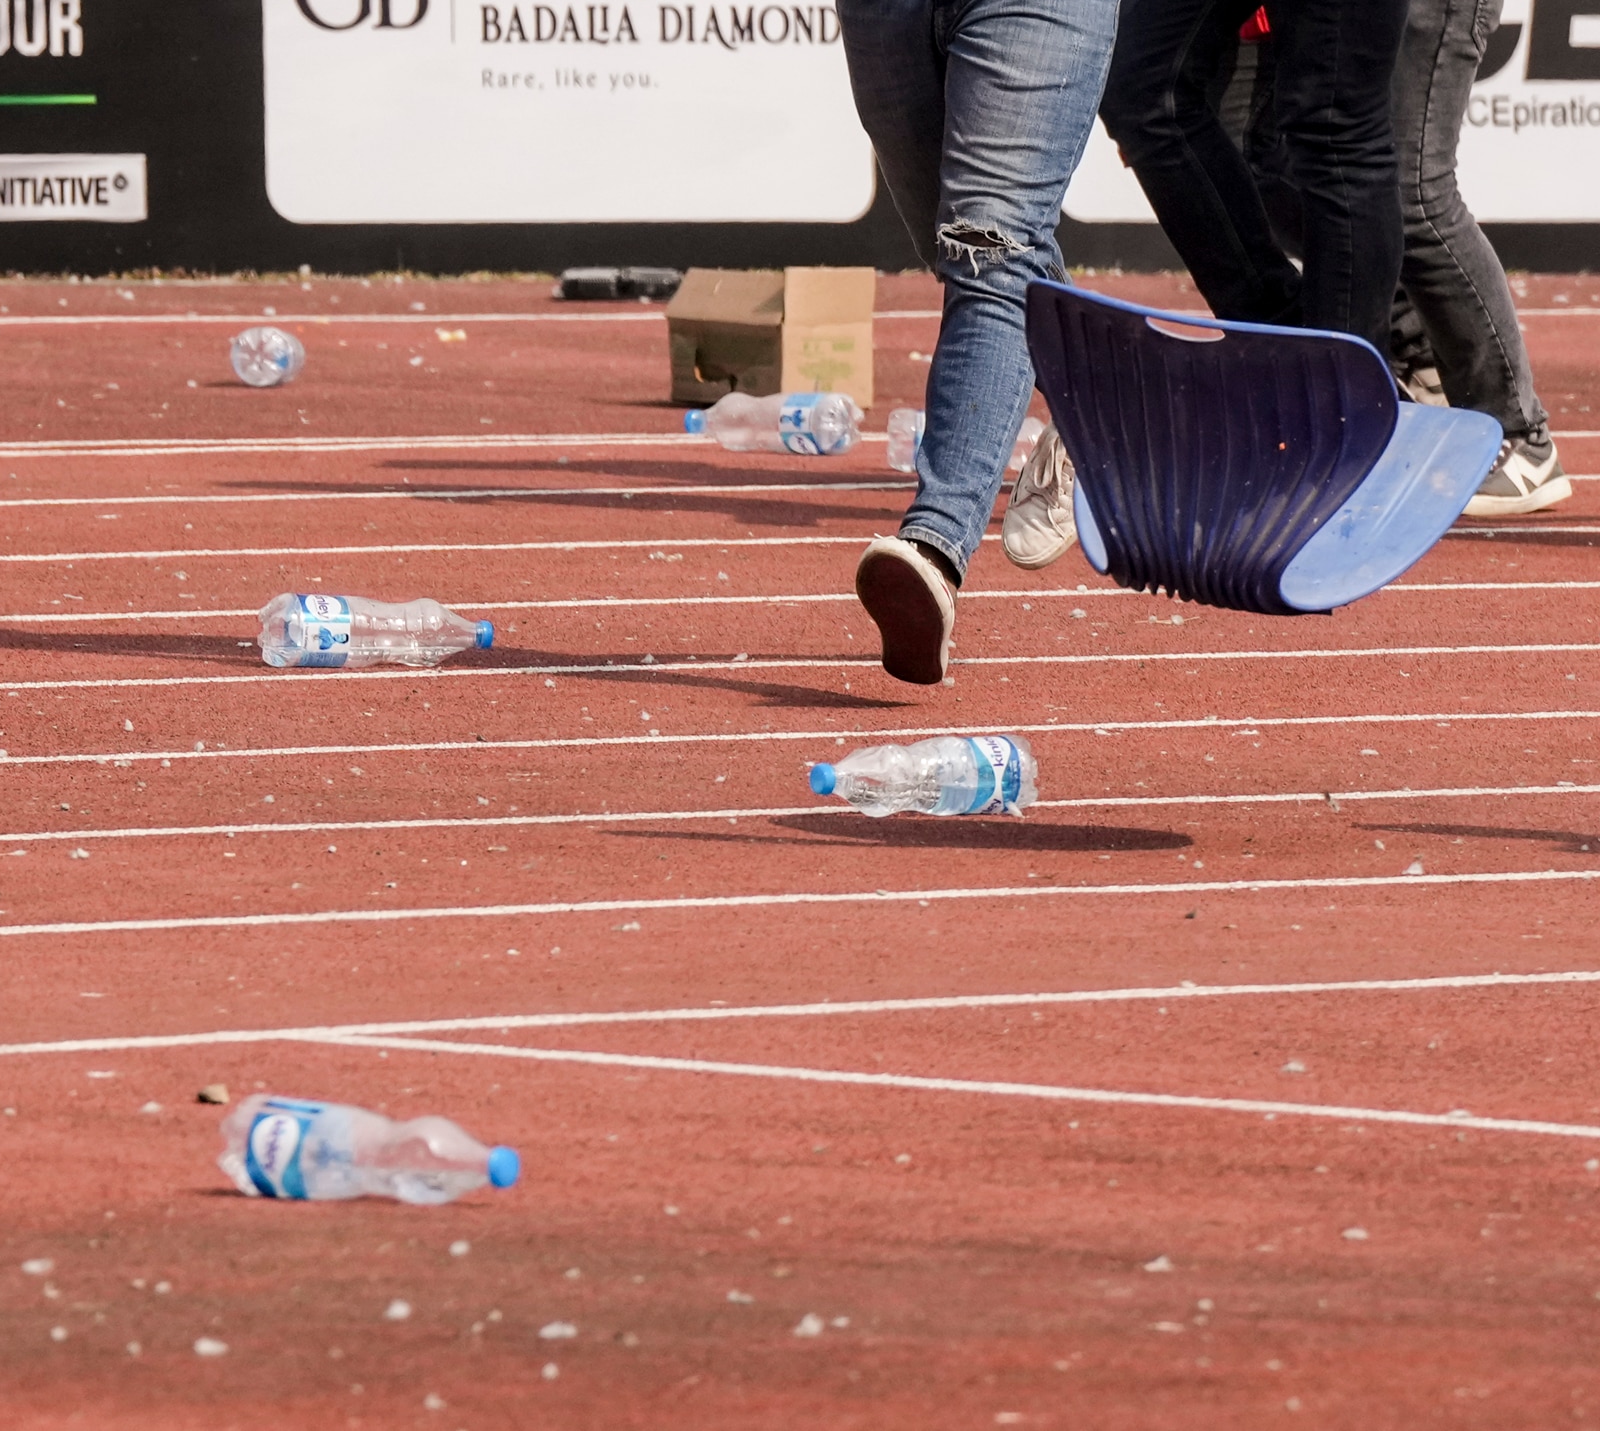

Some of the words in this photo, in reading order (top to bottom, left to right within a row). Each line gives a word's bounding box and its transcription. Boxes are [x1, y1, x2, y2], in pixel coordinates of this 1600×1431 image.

[480, 4, 640, 47] BADALIA
[659, 5, 842, 51] DIAMOND
[481, 68, 547, 91] Rare,
[555, 68, 599, 90] like
[609, 72, 661, 97] you.
